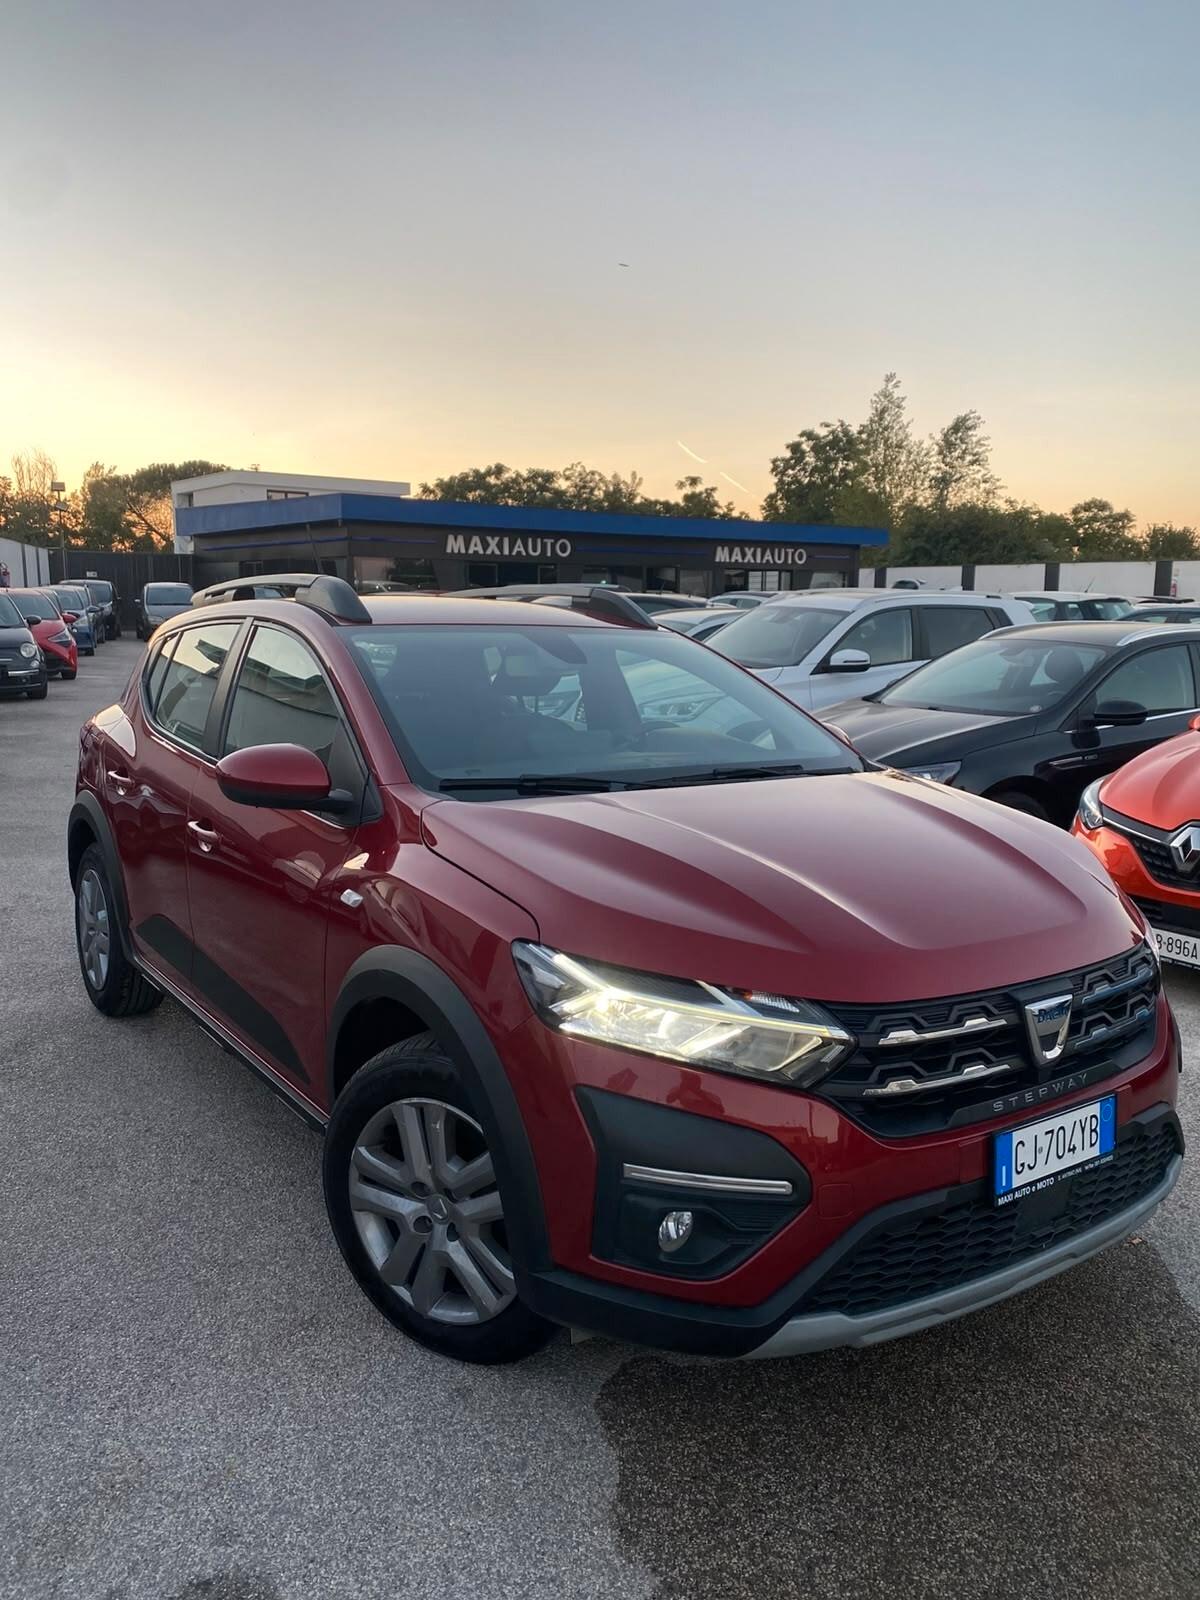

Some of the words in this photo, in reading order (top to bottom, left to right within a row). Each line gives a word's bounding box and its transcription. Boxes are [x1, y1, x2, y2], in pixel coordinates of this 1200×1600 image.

[446, 534, 572, 557] MAXIAUTO
[715, 546, 807, 564] MAXIAUTO
[993, 1073, 1087, 1112] STEPWAY
[998, 1193, 1014, 1206] MAXI
[1014, 1186, 1031, 1200] AUTO
[1036, 1177, 1055, 1191] MOTO
